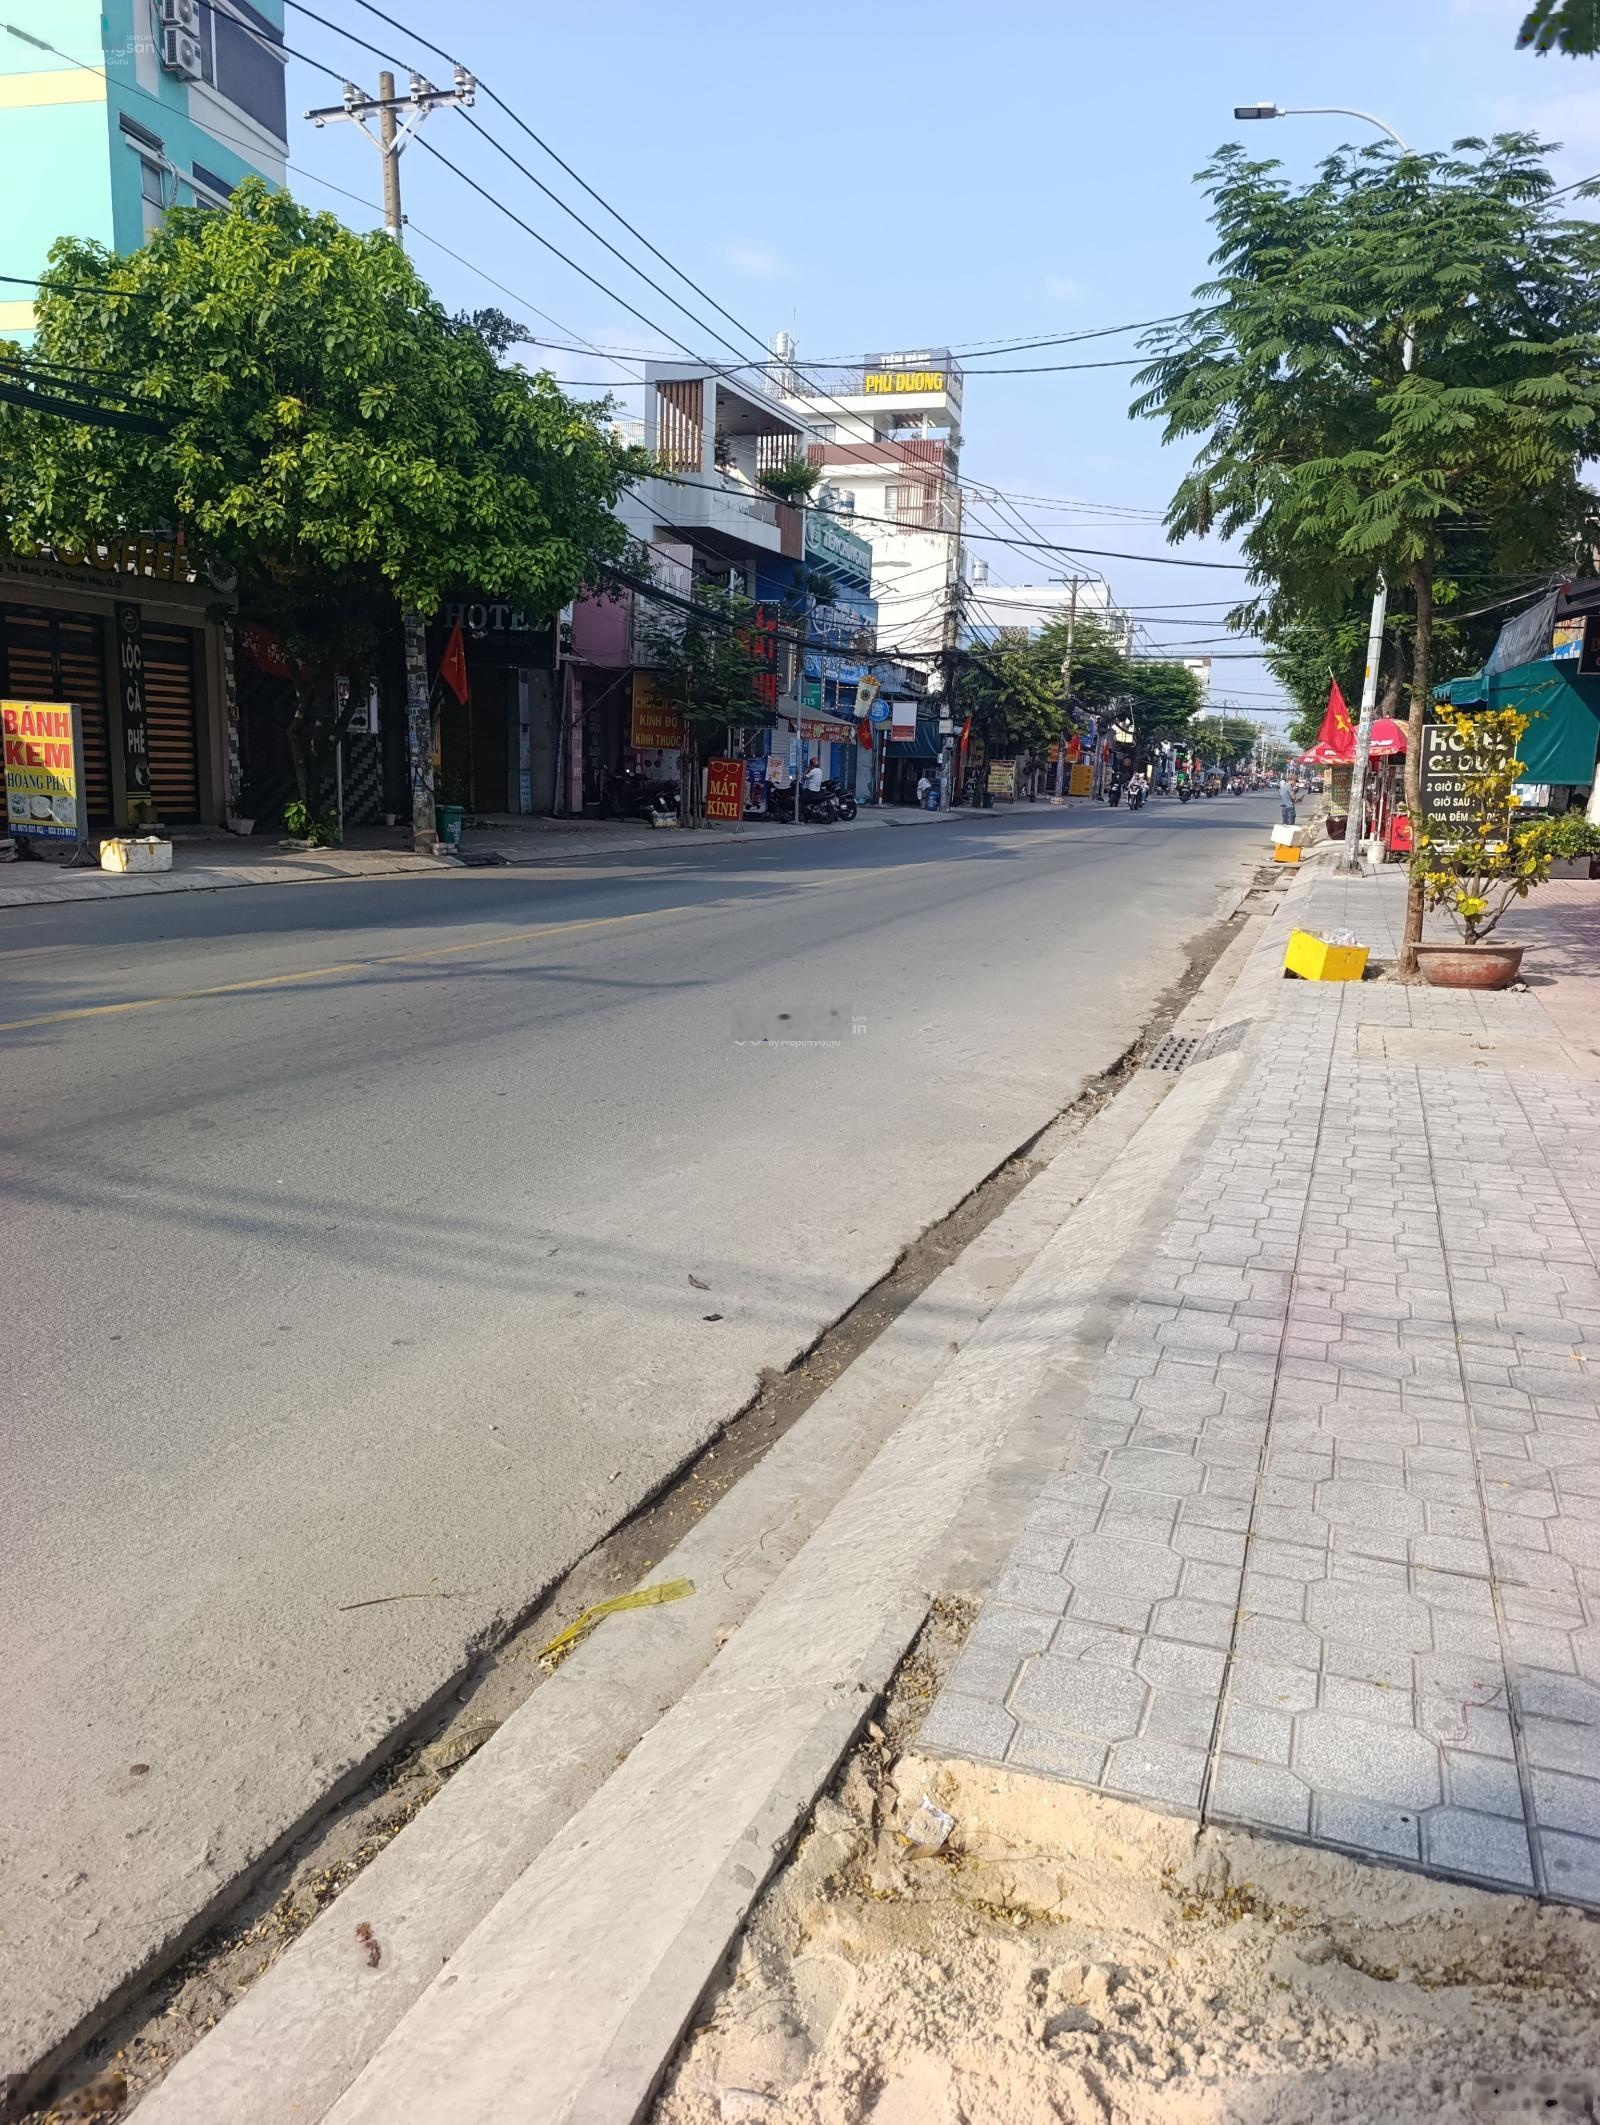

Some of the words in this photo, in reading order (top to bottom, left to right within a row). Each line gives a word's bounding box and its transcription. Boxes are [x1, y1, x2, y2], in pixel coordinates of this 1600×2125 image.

[121, 636, 143, 677] LỘC
[126, 679, 142, 712] CÀ
[4, 705, 70, 739] BÁNH
[127, 721, 146, 754] PHÊ
[5, 740, 72, 769] KEM
[7, 768, 44, 790] HOÀNG
[46, 771, 74, 792] PHÁT
[710, 774, 738, 797] MẮT
[1426, 782, 1433, 792] 2
[1434, 780, 1452, 792] GIỜ
[707, 797, 739, 817] KÍNH
[1433, 795, 1451, 807] GIỜ
[1453, 797, 1471, 807] SAU
[1449, 811, 1469, 822] ĐÊM
